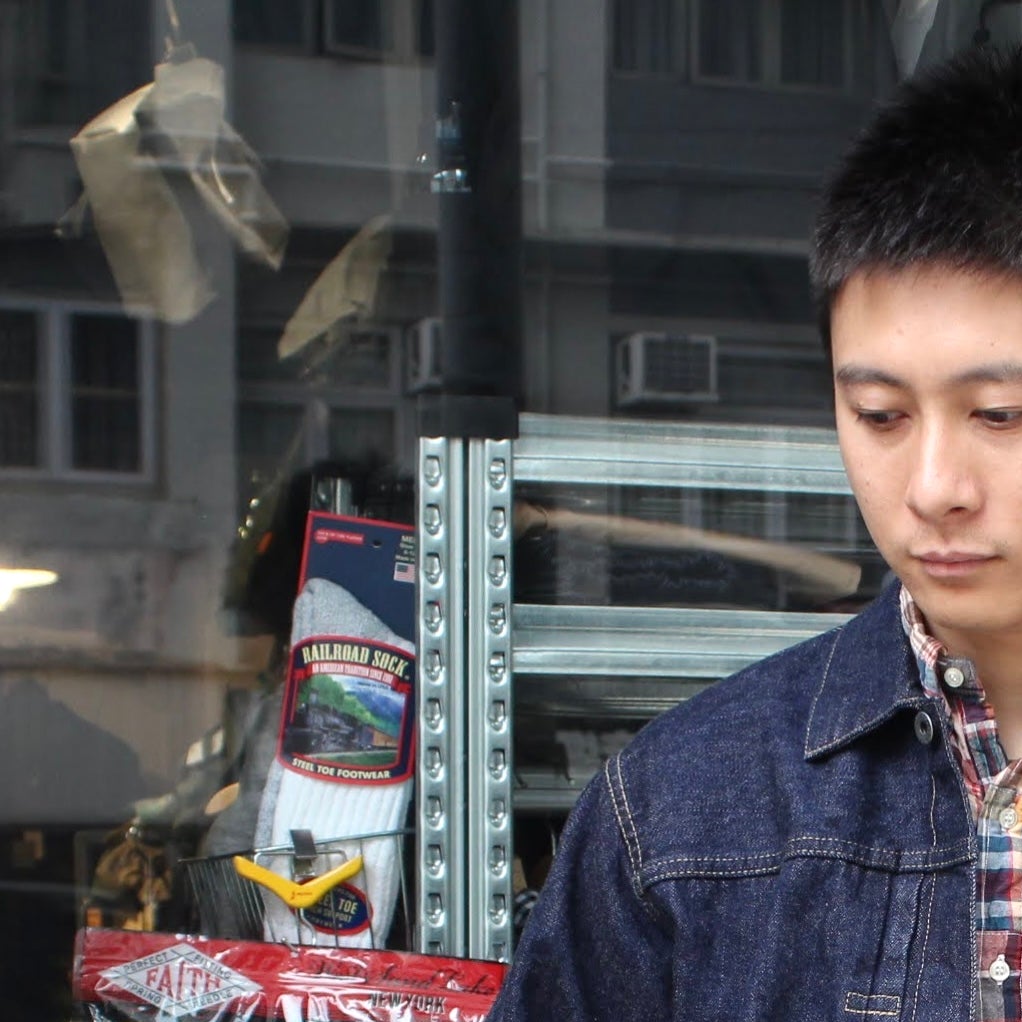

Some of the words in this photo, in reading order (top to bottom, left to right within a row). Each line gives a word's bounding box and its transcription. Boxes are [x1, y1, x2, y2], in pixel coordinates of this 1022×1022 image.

[302, 643, 370, 664] RAILROAD
[371, 650, 408, 677] SOCK
[292, 758, 315, 772] STEEL
[317, 764, 335, 776] TOE
[337, 768, 392, 779] FOOTWEAR
[338, 898, 358, 914] TOE
[124, 951, 168, 973] PERFECT
[146, 959, 220, 1001] FAITH
[370, 992, 402, 1010] NEW
[401, 993, 446, 1015] YORK
